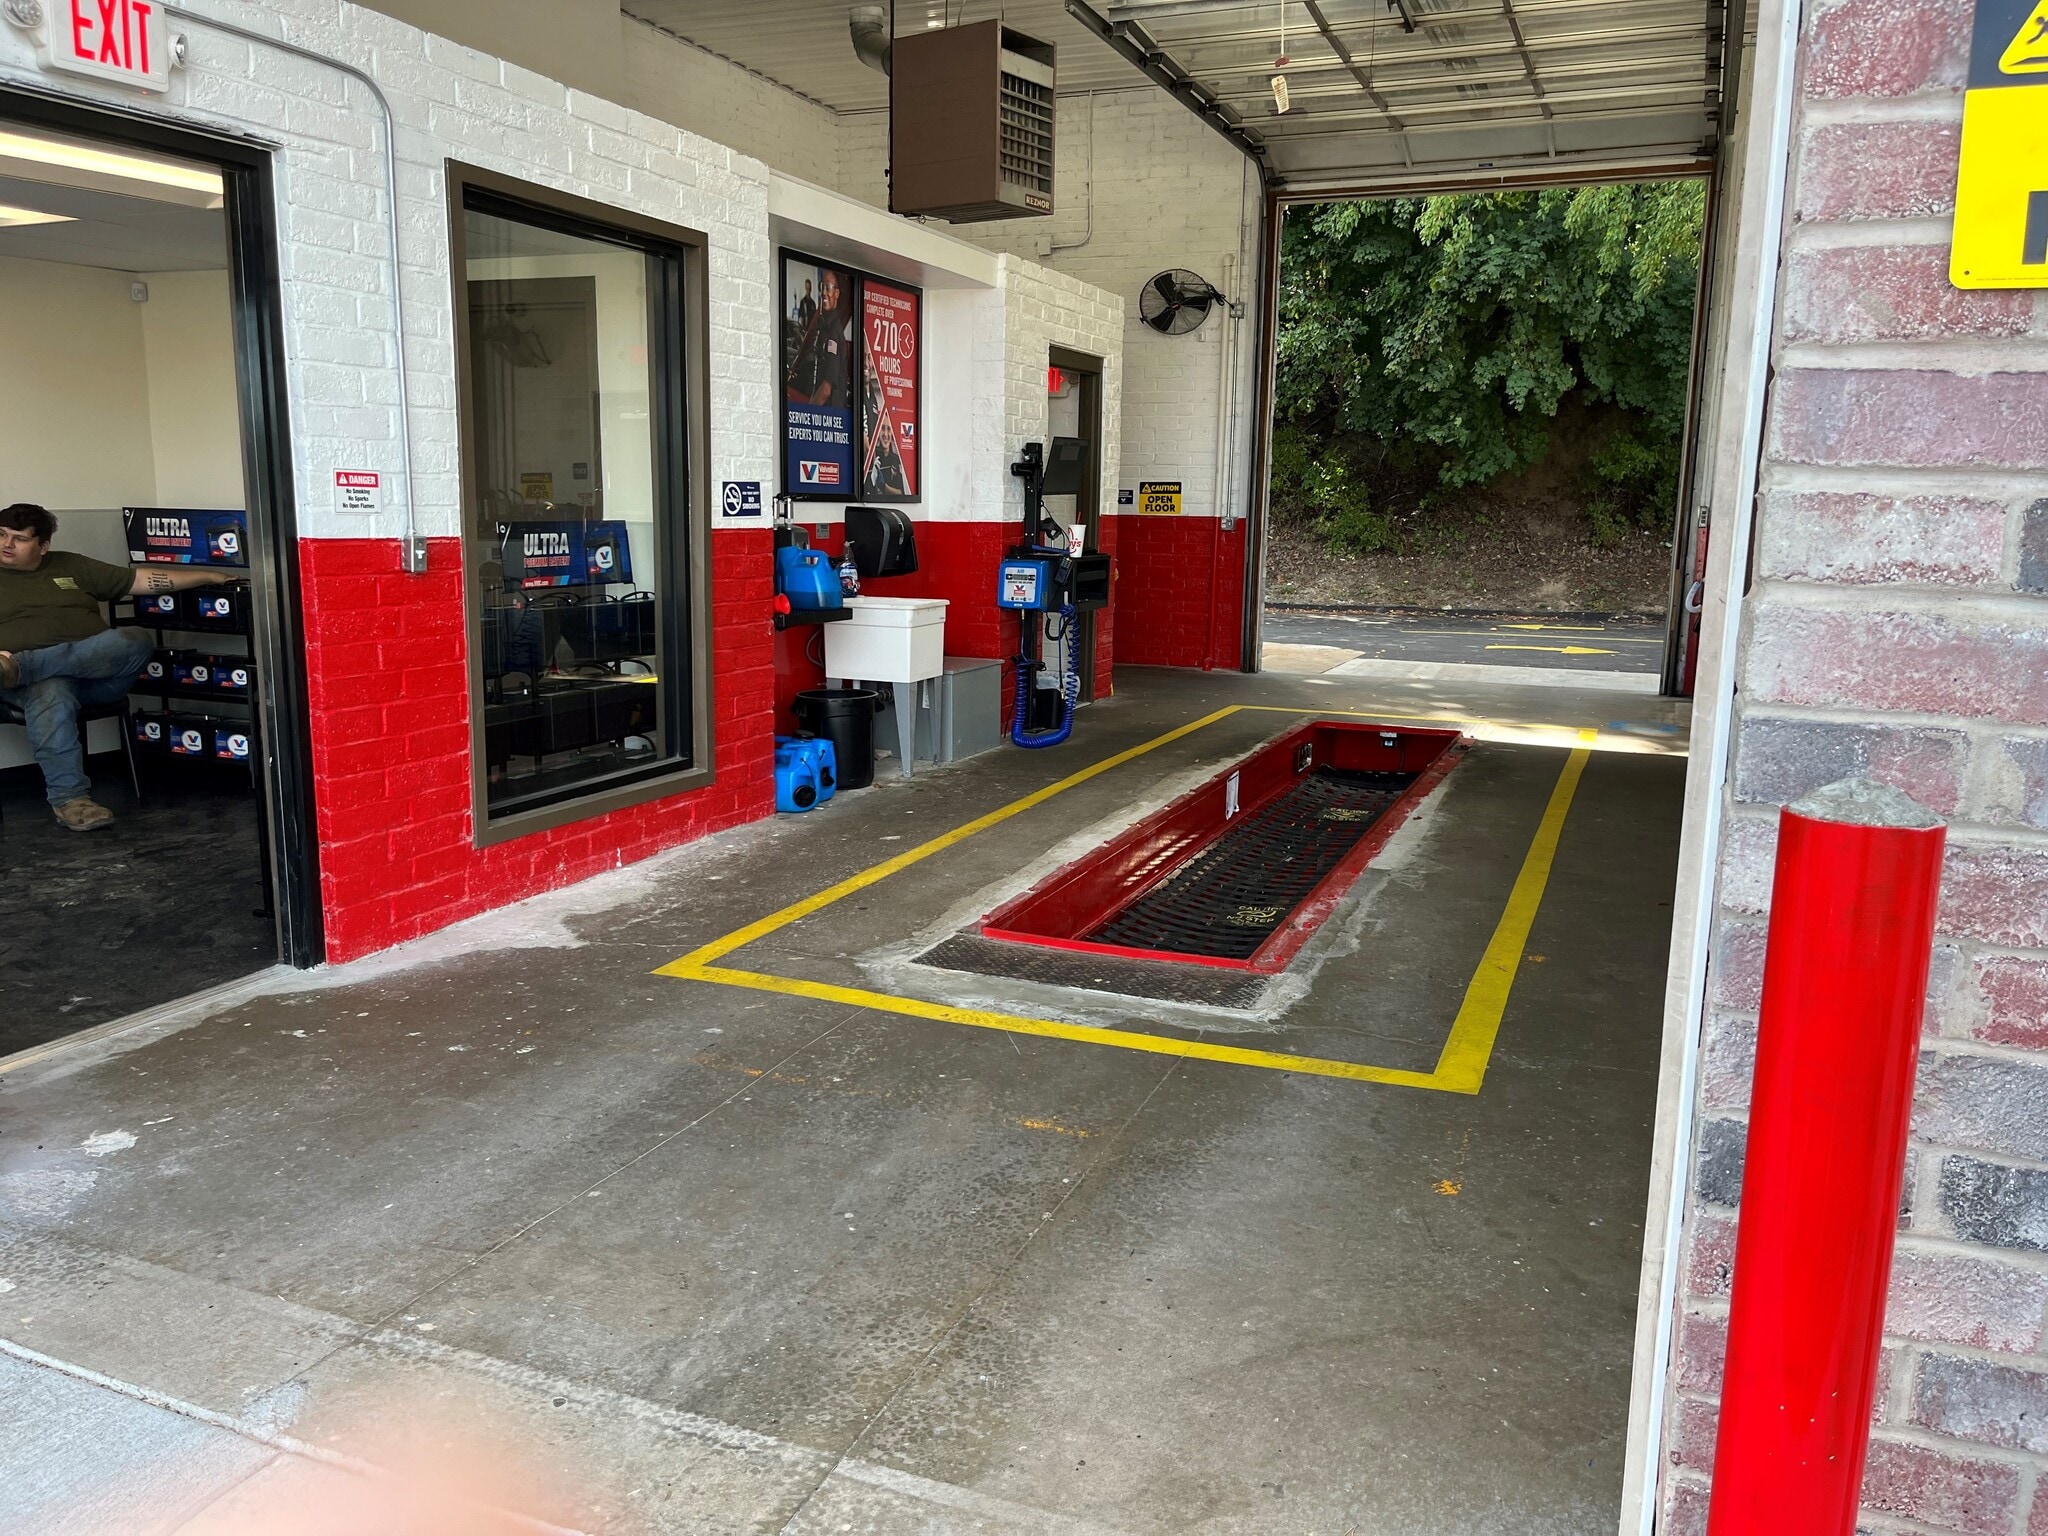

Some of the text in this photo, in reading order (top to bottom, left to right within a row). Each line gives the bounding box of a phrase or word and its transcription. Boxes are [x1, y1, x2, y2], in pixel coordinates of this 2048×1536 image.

[71, 0, 151, 74] EXIT
[1026, 196, 1050, 210] REZNOR
[872, 292, 889, 306] CERTIFIED
[890, 297, 912, 312] TECHNICIANS
[867, 304, 894, 319] COMPLETE OVER
[874, 319, 898, 354] 270
[880, 356, 900, 374] HOURS
[788, 411, 843, 429] SERVICE YOU CAN SEE.
[789, 427, 849, 444] EXPERTS YOU CAN TRUST.
[349, 475, 376, 485] DANGER
[1145, 504, 1176, 512] FLOOR
[1148, 496, 1173, 504] OPEN
[146, 518, 191, 537] ULTRA
[524, 533, 570, 556] ULTRA
[524, 556, 570, 568] PREMIUM BATTERY
